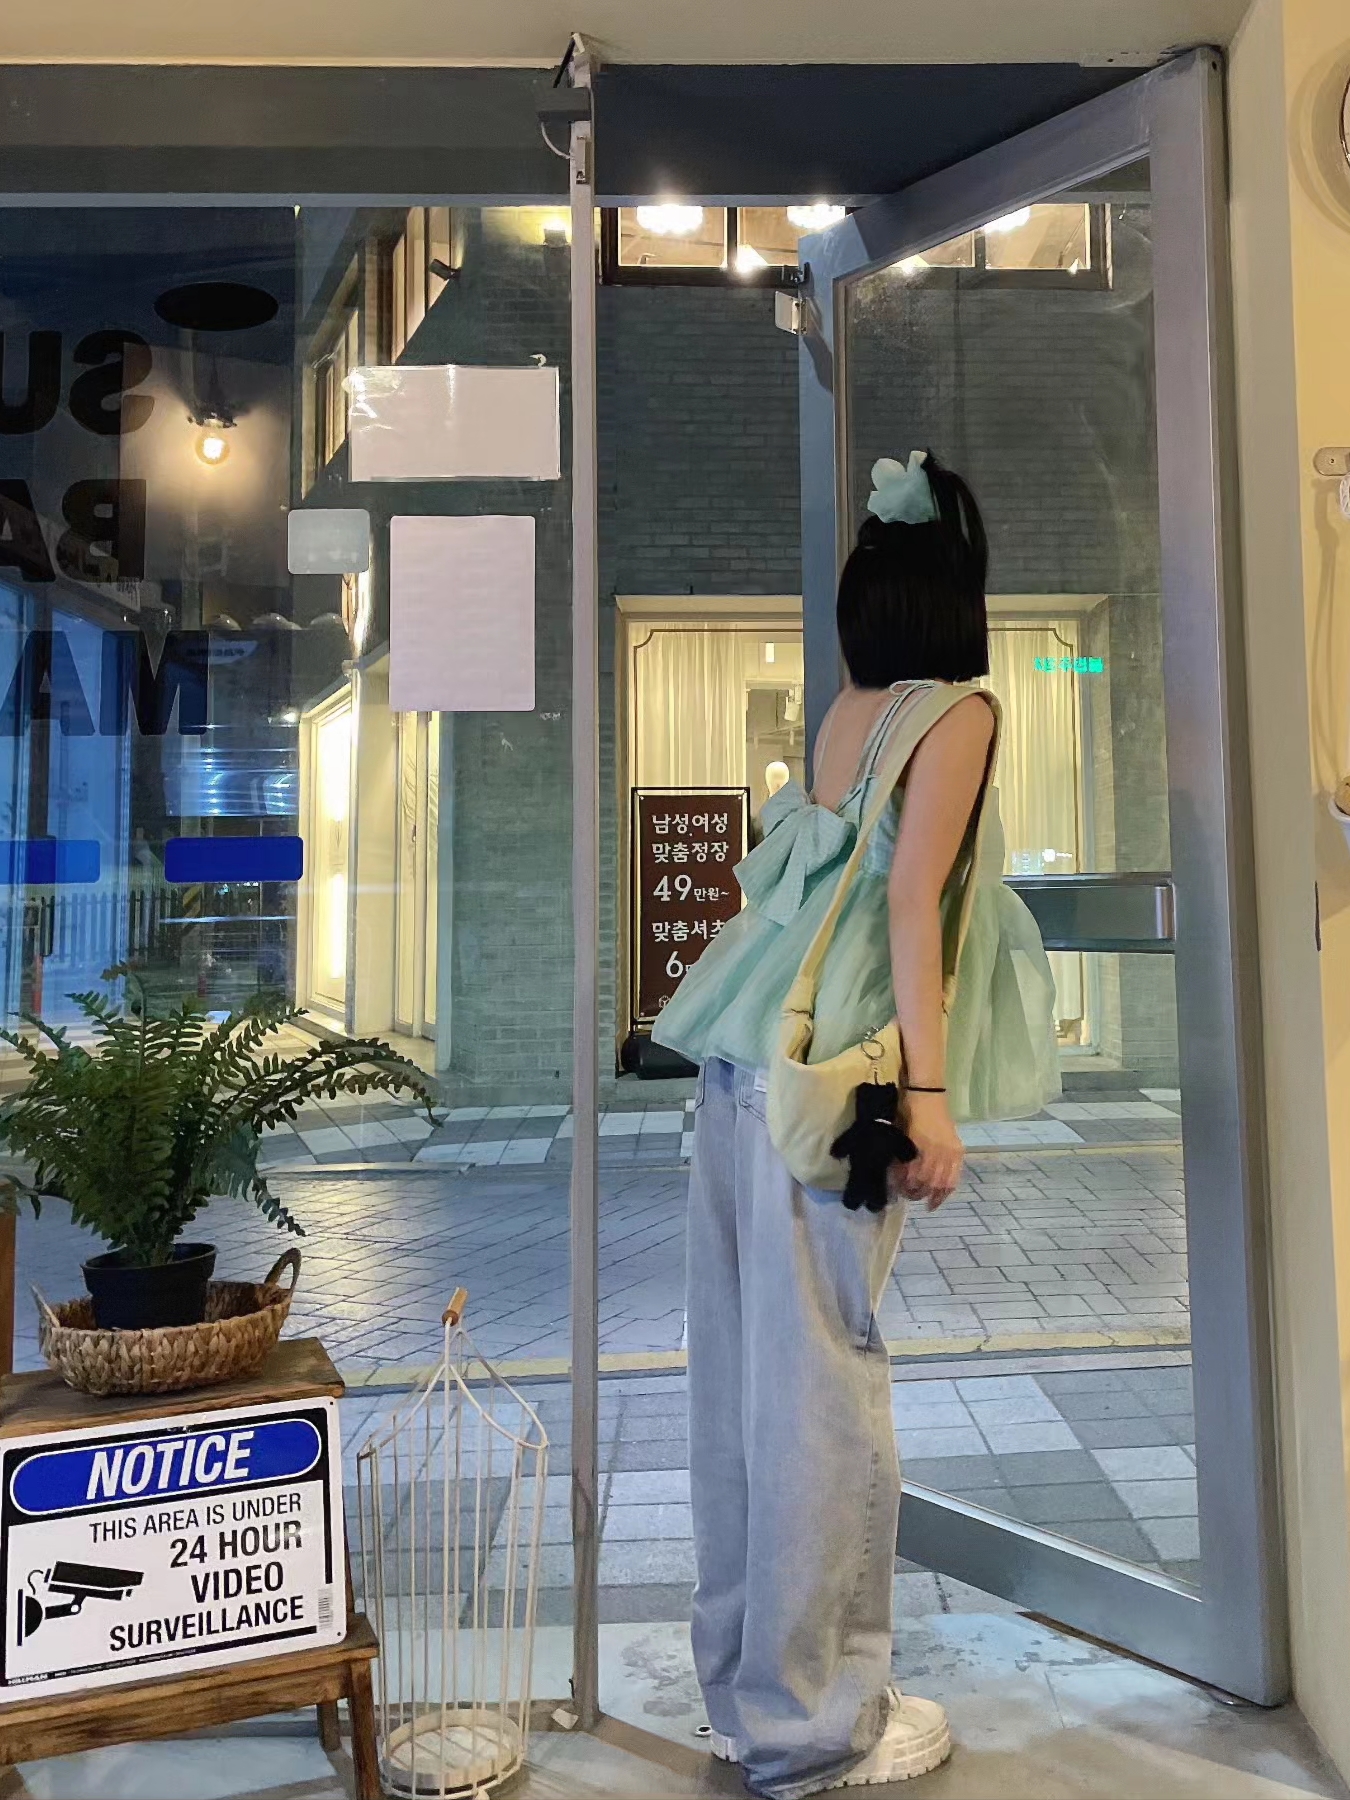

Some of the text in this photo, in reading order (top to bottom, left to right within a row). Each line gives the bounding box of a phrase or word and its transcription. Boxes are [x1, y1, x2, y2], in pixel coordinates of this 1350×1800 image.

[651, 841, 730, 864] 맞춤정장
[86, 1430, 255, 1500] NOTICE
[89, 1492, 302, 1543] THIS AREA IS UNDER
[169, 1520, 303, 1568] 24 HOUR
[190, 1561, 284, 1604] VIDEO
[109, 1595, 304, 1652] SURVEILLANCE
